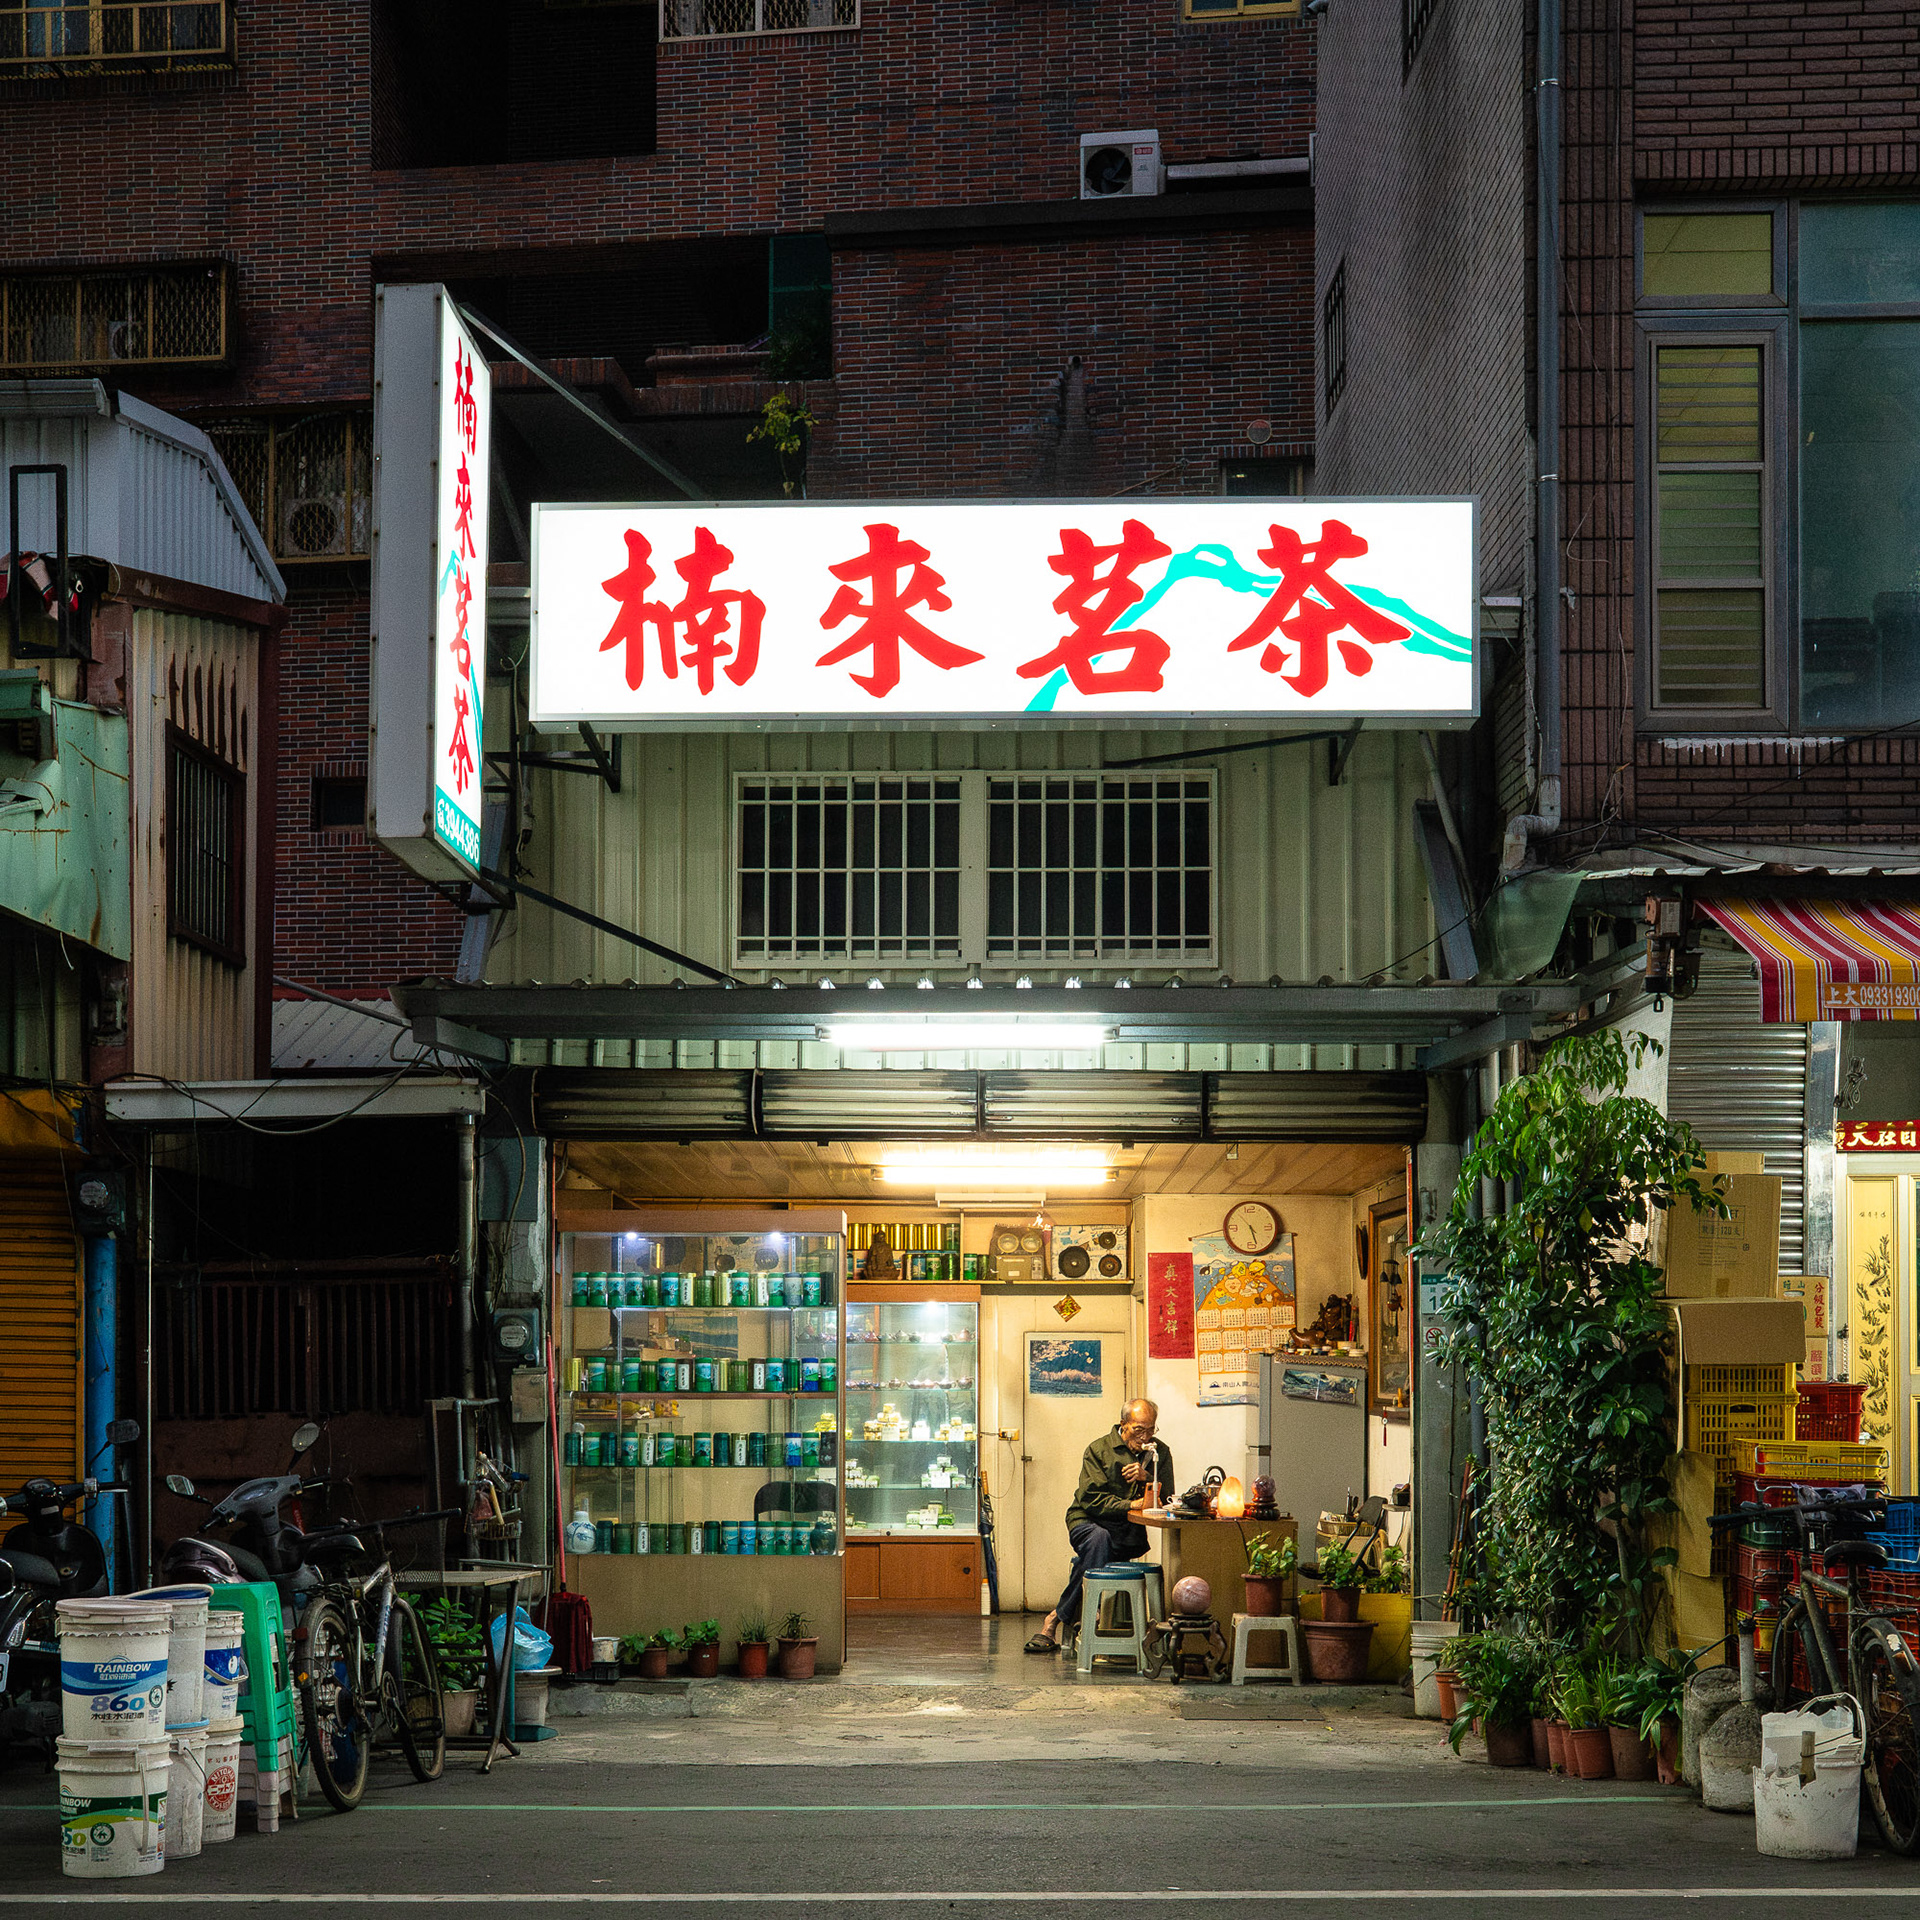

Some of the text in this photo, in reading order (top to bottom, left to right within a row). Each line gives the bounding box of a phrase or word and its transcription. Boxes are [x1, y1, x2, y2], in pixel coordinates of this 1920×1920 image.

[448, 336, 478, 794] 楠來茗茶
[600, 518, 1411, 699] 楠來茗茶
[90, 1693, 145, 1712] 860
[93, 1663, 152, 1674] RAINBOW
